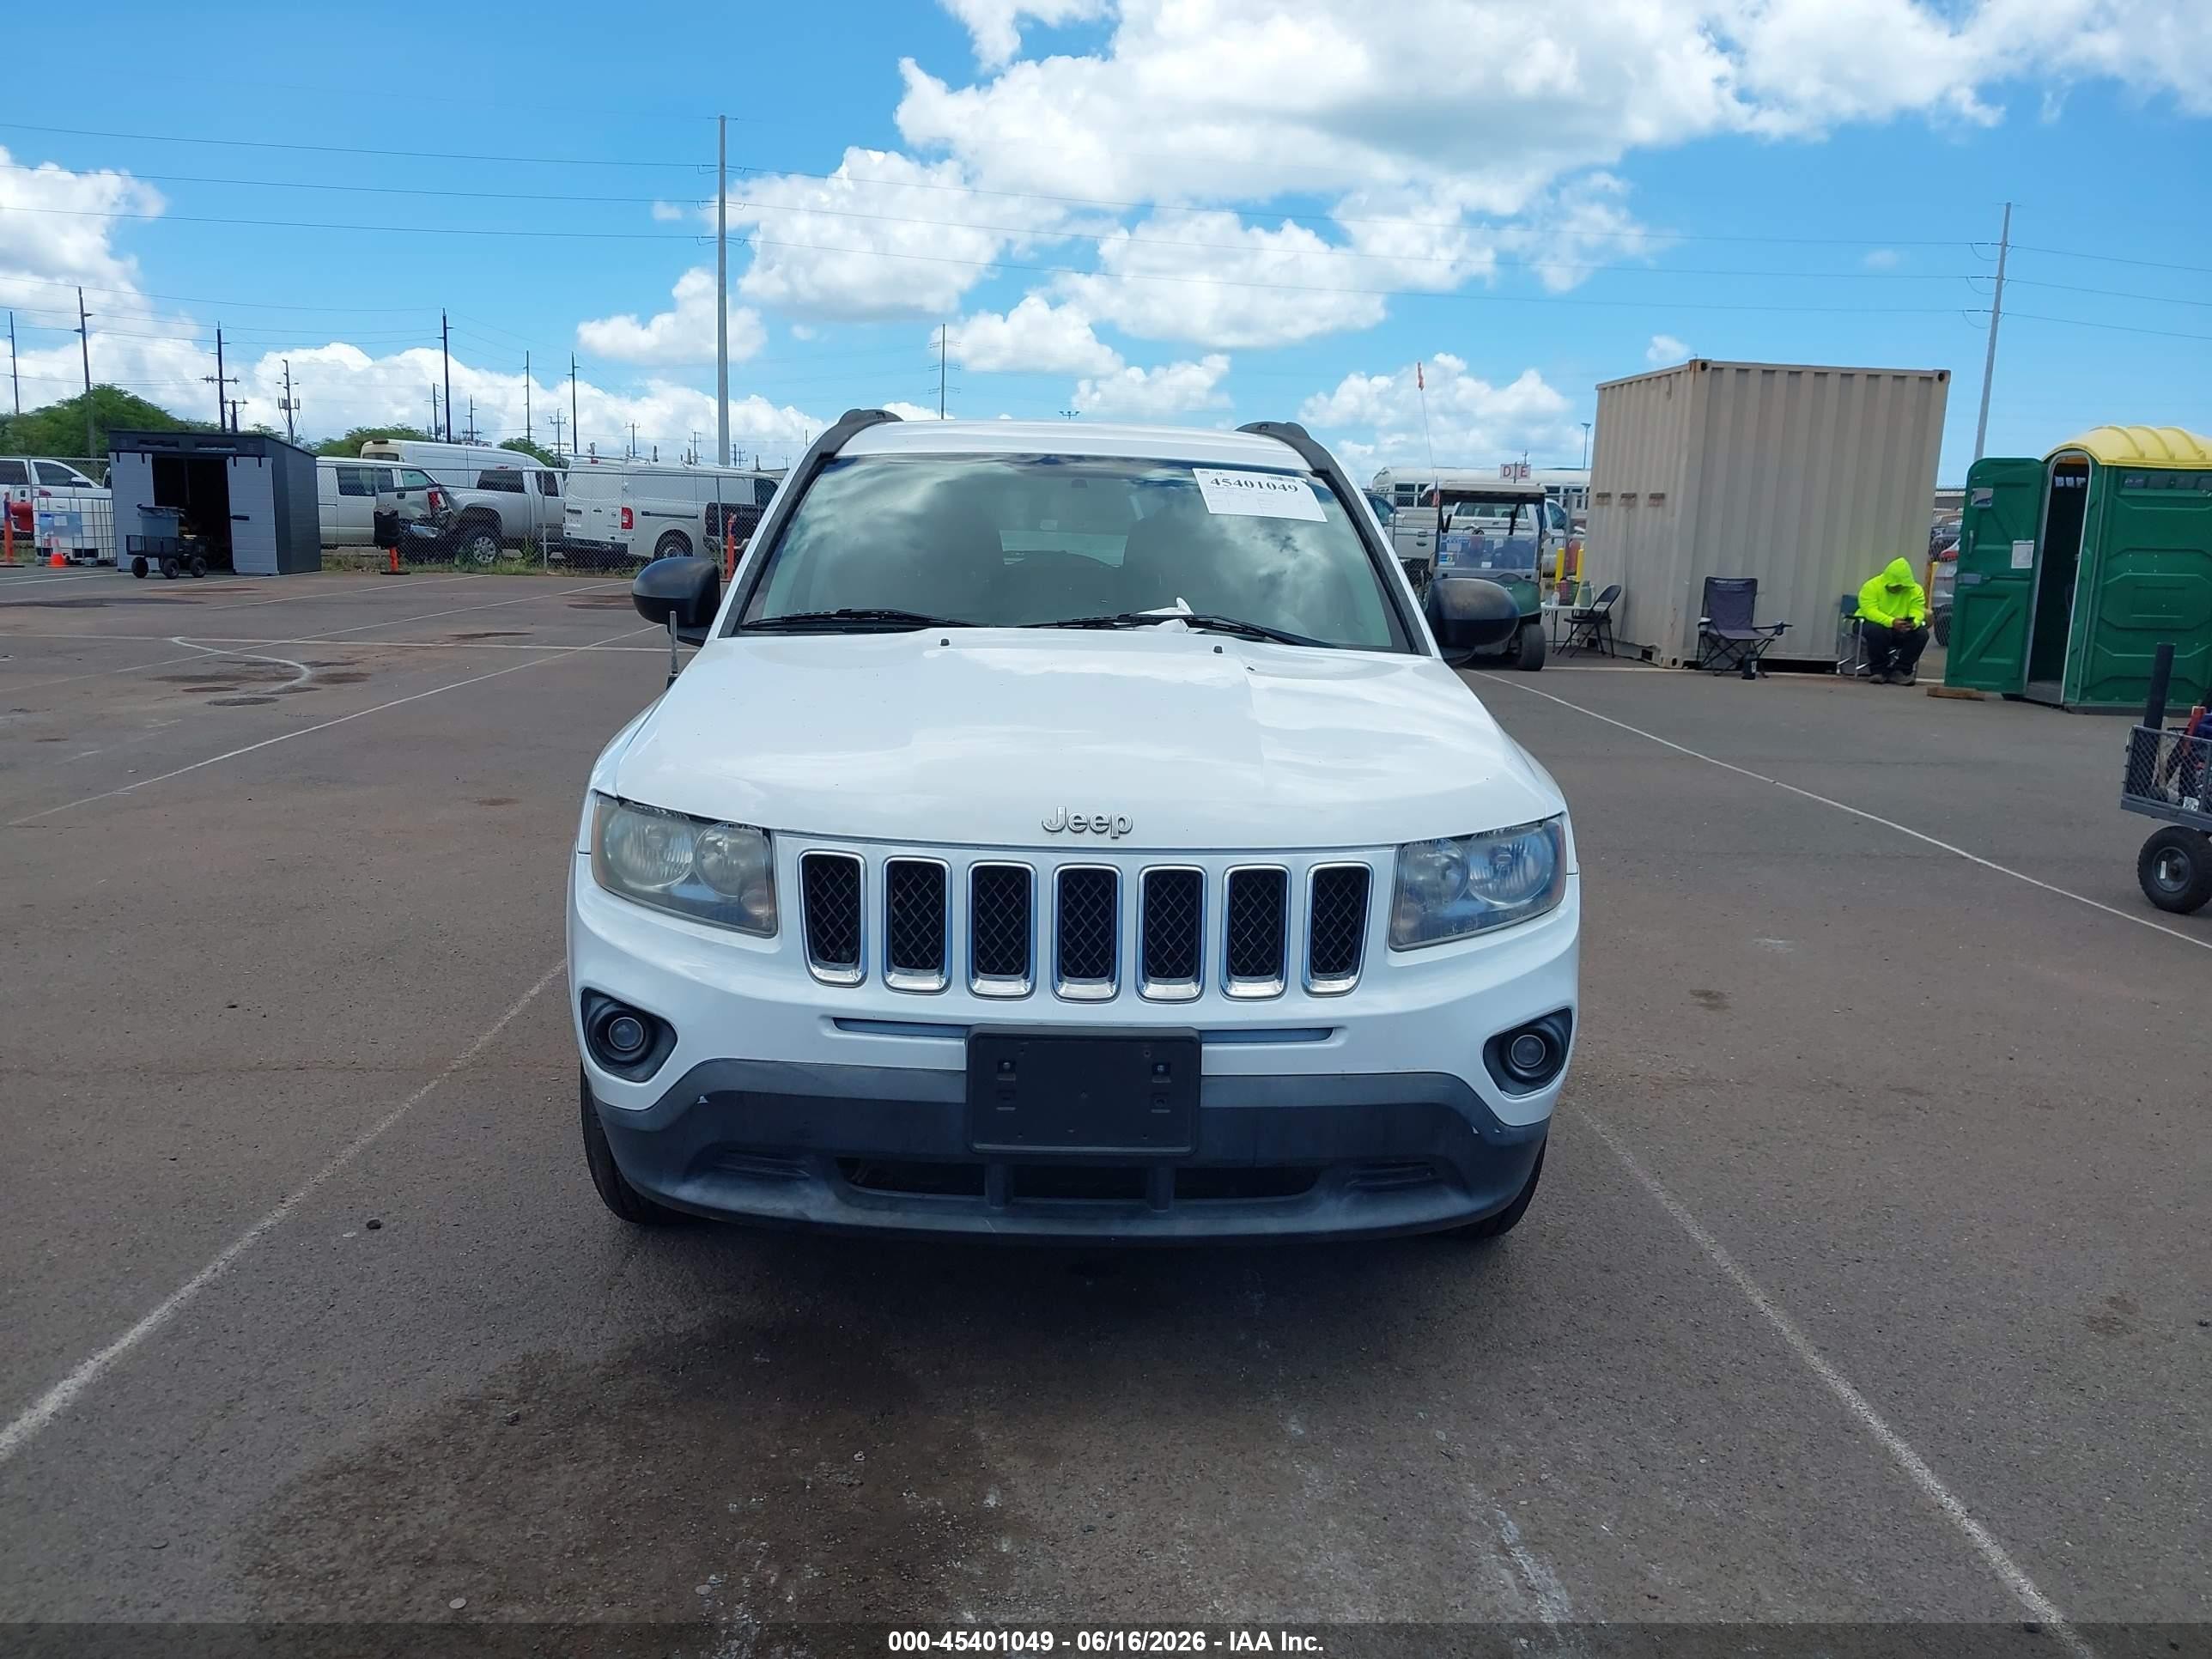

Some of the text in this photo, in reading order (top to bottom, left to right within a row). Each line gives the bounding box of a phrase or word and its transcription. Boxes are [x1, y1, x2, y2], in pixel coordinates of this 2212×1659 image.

[1503, 465, 1511, 477] D
[1520, 465, 1528, 477] E
[1210, 477, 1299, 493] 45401049
[1041, 805, 1133, 840] Jeep
